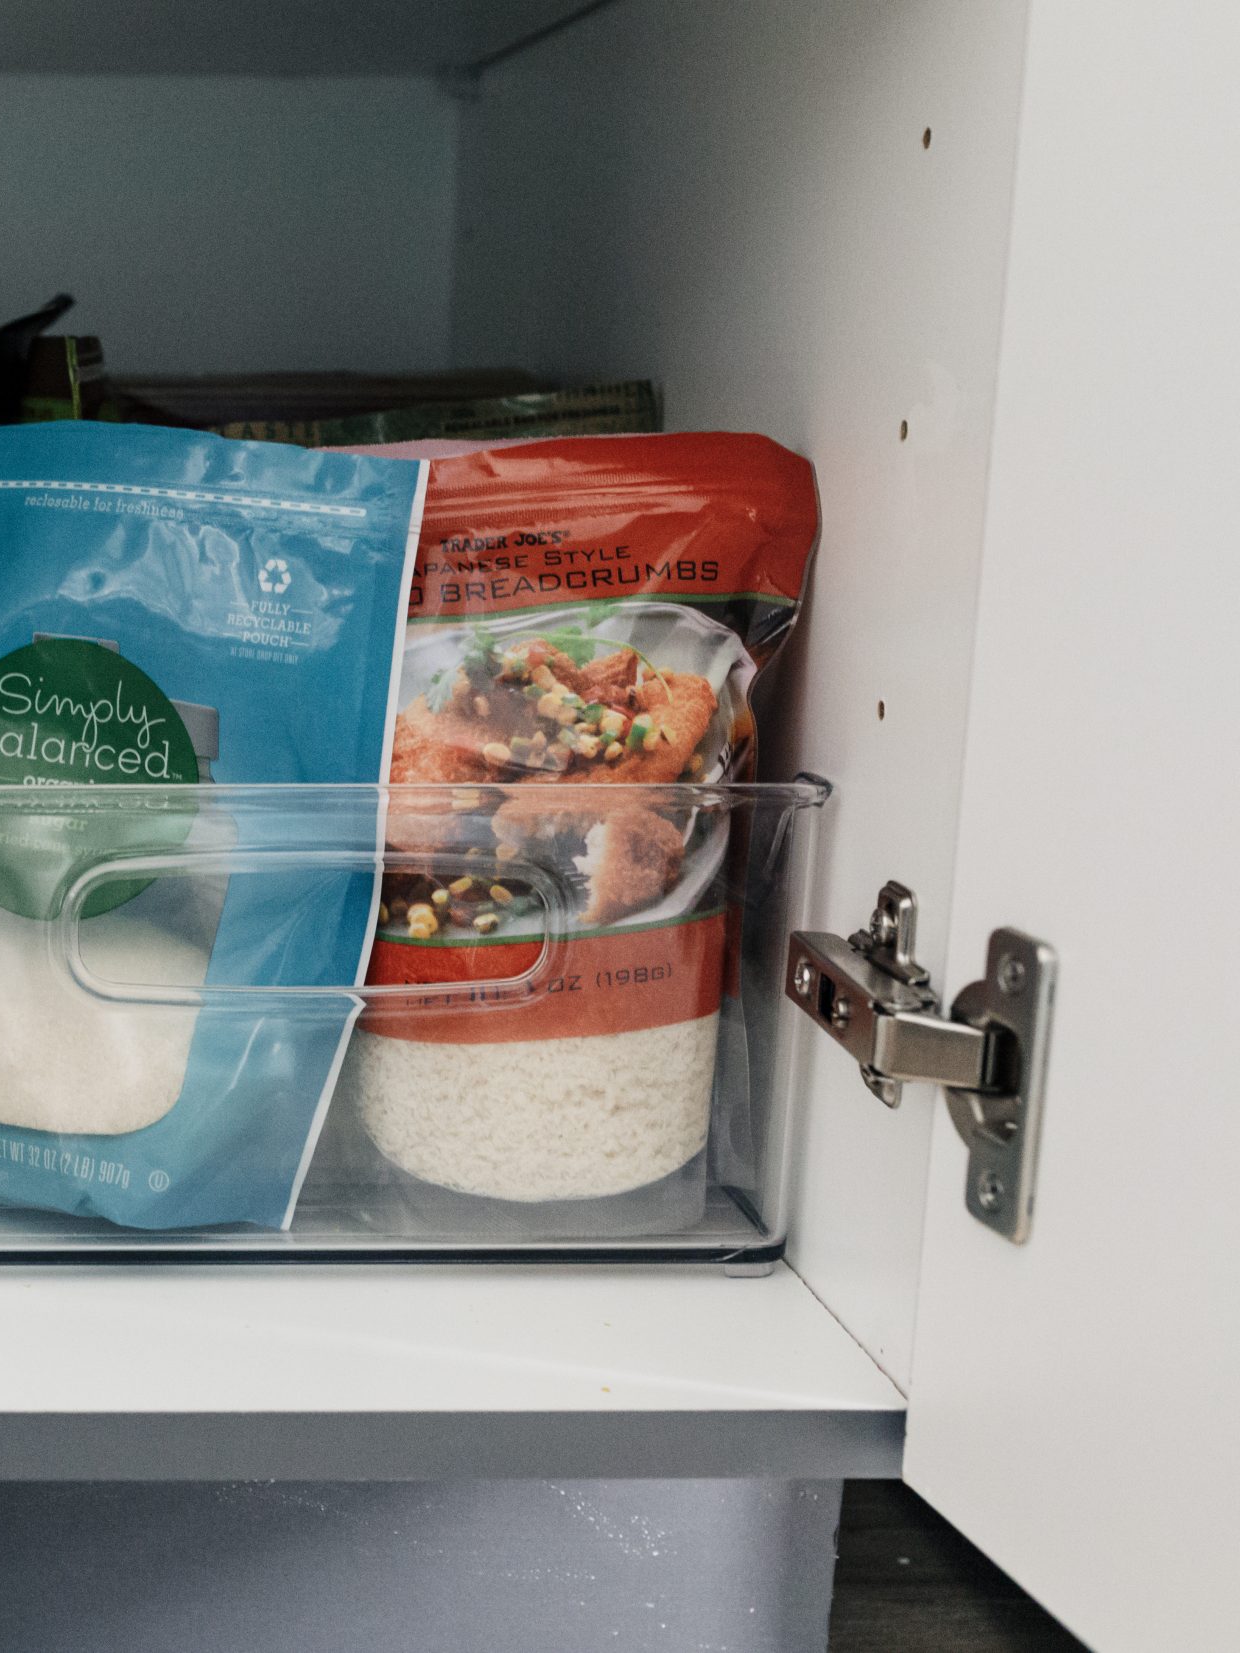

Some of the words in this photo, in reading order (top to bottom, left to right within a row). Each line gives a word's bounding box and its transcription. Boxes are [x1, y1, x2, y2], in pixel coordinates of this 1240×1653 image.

[24, 493, 89, 511] reclosable
[94, 497, 112, 513] for
[115, 499, 185, 520] freshness
[440, 535, 509, 554] TRADER
[514, 529, 564, 547] JOE'S
[544, 546, 632, 567] STYLE
[440, 560, 719, 604] BREADCRUMBS
[251, 599, 291, 617] FULLY
[227, 613, 313, 636] RECYCLABLE
[242, 630, 291, 649] POUCH
[547, 975, 583, 994] OZ
[595, 962, 673, 988] (198G)
[9, 1140, 25, 1164] WT
[28, 1144, 41, 1168] 32
[43, 1147, 57, 1171] OZ
[60, 1151, 72, 1175] (2
[73, 1154, 95, 1182] LB)
[98, 1160, 131, 1190] 907g
